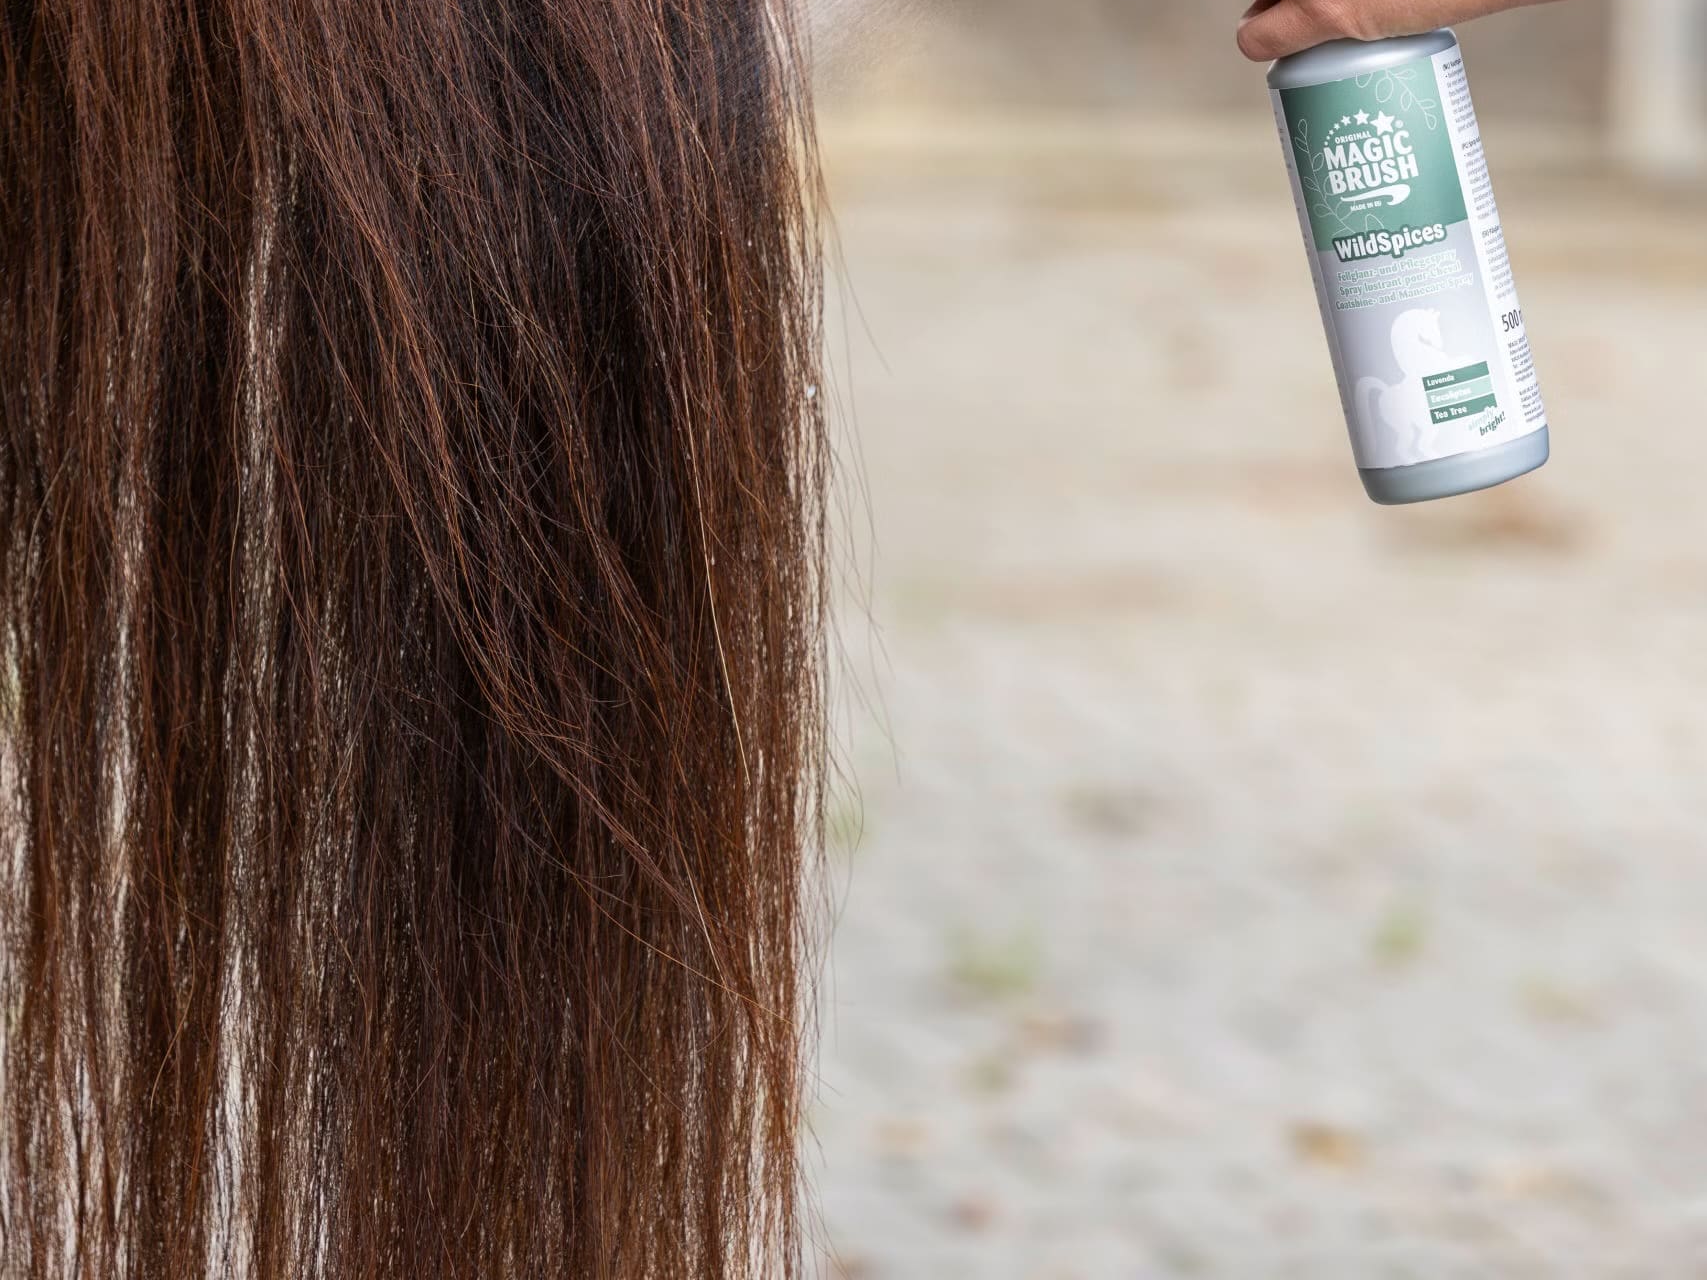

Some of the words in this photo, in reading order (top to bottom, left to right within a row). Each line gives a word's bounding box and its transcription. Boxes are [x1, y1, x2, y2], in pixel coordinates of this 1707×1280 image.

[1334, 131, 1372, 144] ORIGINAL
[1323, 130, 1413, 170] MAGIC
[1328, 153, 1419, 195] BRUSH
[1350, 203, 1366, 212] MADE
[1333, 223, 1446, 260] WildSpices
[1379, 263, 1398, 275] und
[1339, 285, 1362, 297] Spray
[1364, 277, 1402, 292] lustrant
[1404, 272, 1427, 286] pour
[1378, 291, 1398, 304] and
[1399, 281, 1445, 300] Manecare
[1433, 410, 1449, 420] Tea
[1449, 406, 1468, 416] Tree
[1479, 410, 1506, 436] bright!
